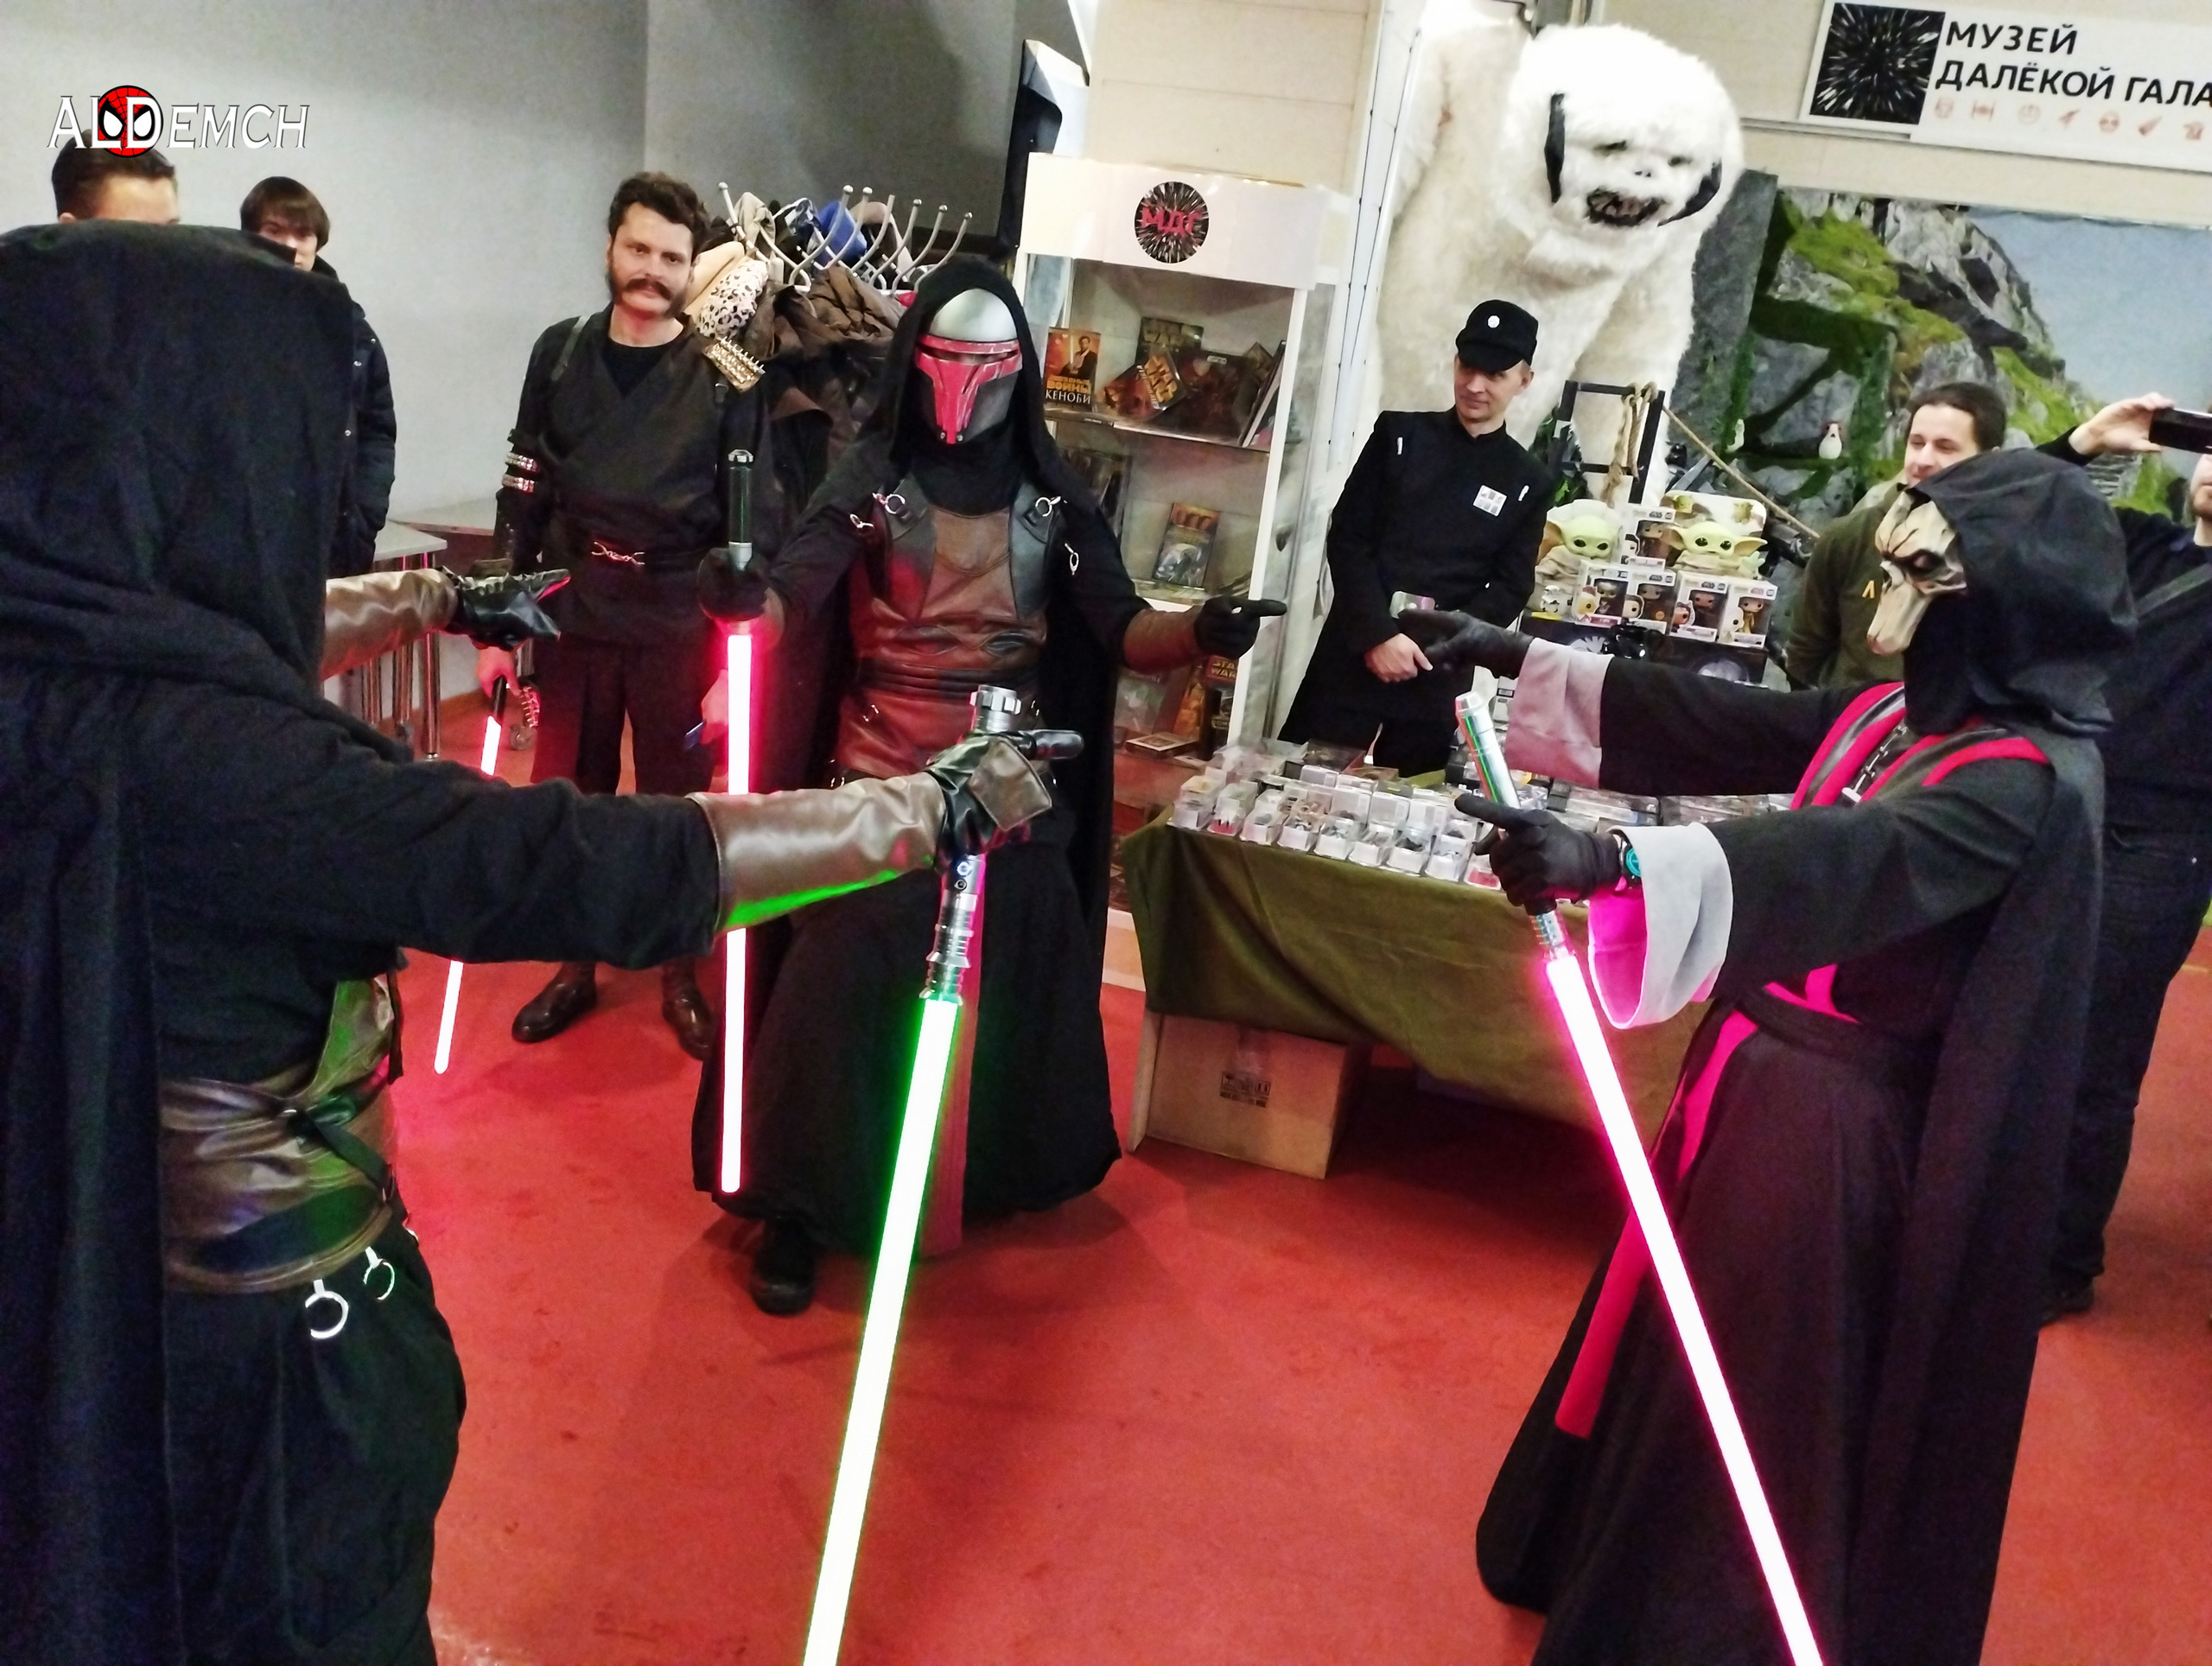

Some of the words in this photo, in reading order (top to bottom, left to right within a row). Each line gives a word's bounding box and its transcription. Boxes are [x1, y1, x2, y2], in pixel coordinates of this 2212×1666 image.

[1946, 22, 2077, 54] МУЗЕЙ
[1935, 60, 2115, 99] ДАЛЁКОЙ
[2125, 77, 2212, 107] ГАЛА
[1045, 389, 1091, 404] КЕНОБИ
[1211, 660, 1236, 670] STA
[1211, 667, 1237, 679] WAR
